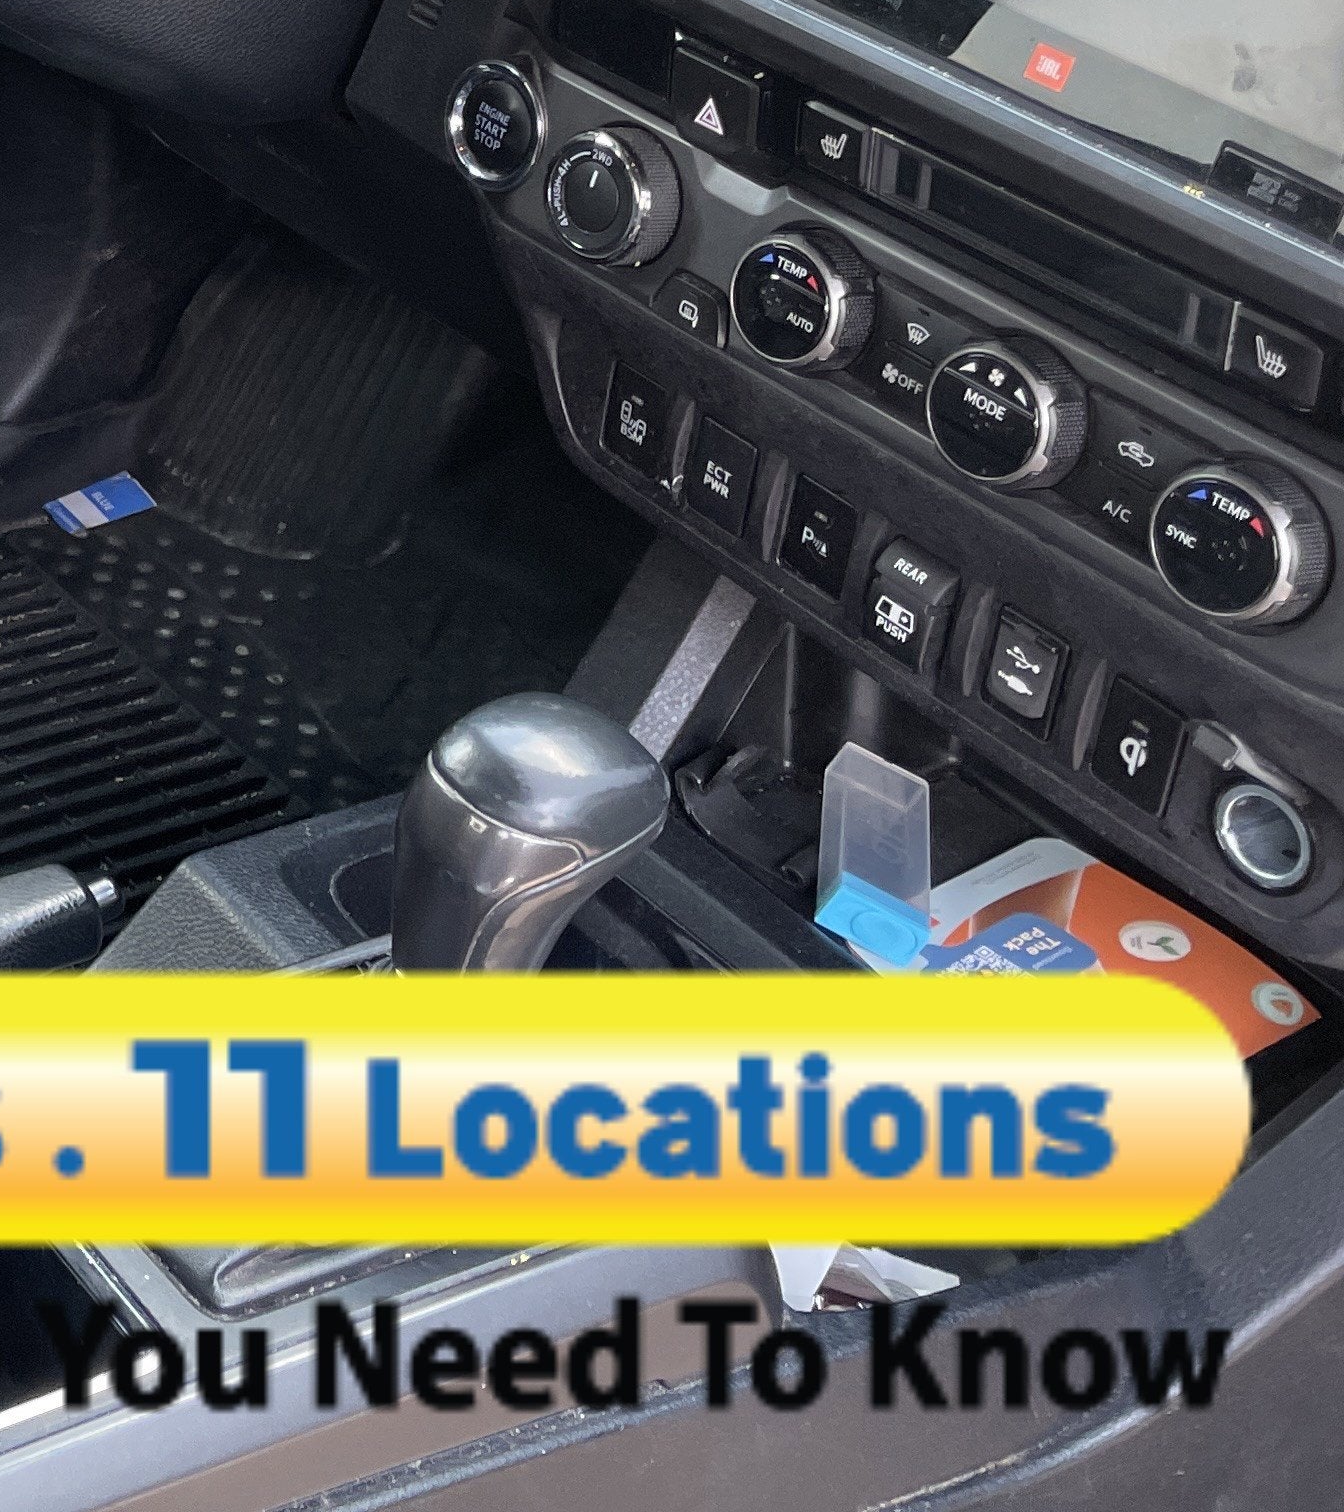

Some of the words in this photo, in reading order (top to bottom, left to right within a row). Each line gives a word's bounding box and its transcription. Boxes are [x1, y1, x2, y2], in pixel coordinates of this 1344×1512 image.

[1035, 53, 1061, 81] JBL
[474, 113, 507, 139] START
[479, 101, 511, 126] ENGINE
[473, 128, 501, 151] STOP
[592, 148, 614, 167] 2WD
[776, 254, 809, 281] TEMP
[786, 311, 814, 334] AUTO
[897, 373, 924, 395] OFF
[963, 387, 1007, 422] MODE
[706, 459, 733, 483] ECT
[703, 472, 730, 500] PWR
[1101, 498, 1133, 525] A/C
[1211, 491, 1251, 523] TEMP
[1164, 522, 1198, 550] SYNC
[893, 557, 928, 586] REAR
[875, 615, 907, 645] PUSH
[1002, 926, 1046, 953] Pack
[1025, 937, 1062, 957] The
